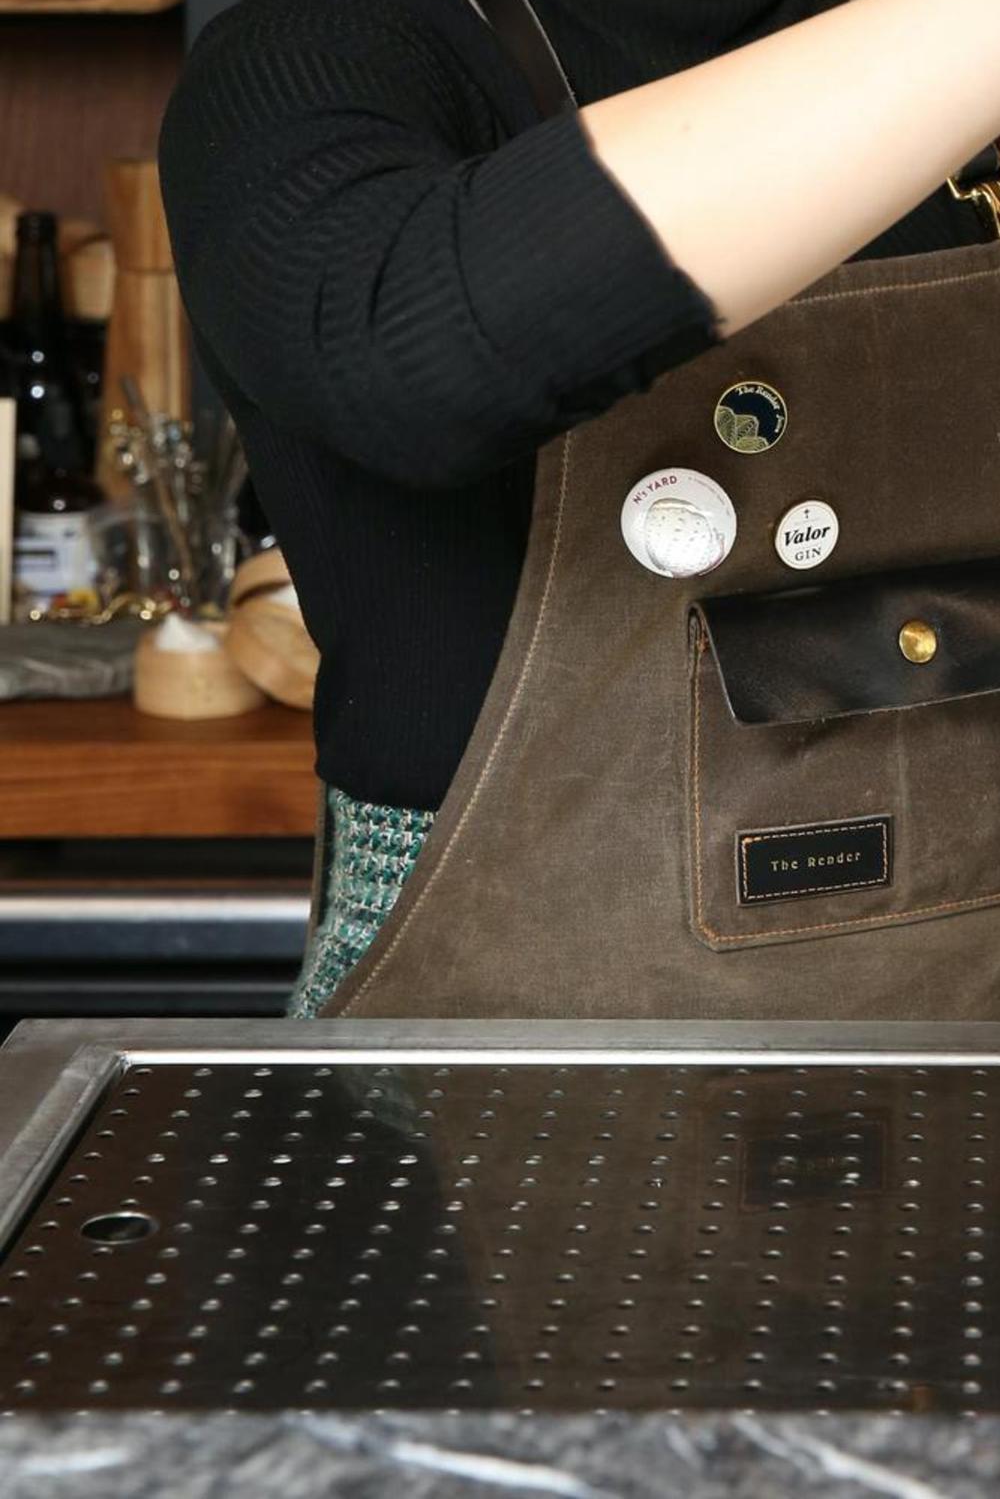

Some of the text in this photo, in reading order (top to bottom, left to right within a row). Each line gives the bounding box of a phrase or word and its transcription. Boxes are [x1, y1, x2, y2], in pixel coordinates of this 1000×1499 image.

[647, 475, 678, 493] YARD
[784, 526, 831, 547] Valor
[794, 548, 822, 562] GIN
[770, 851, 861, 873] The Render
